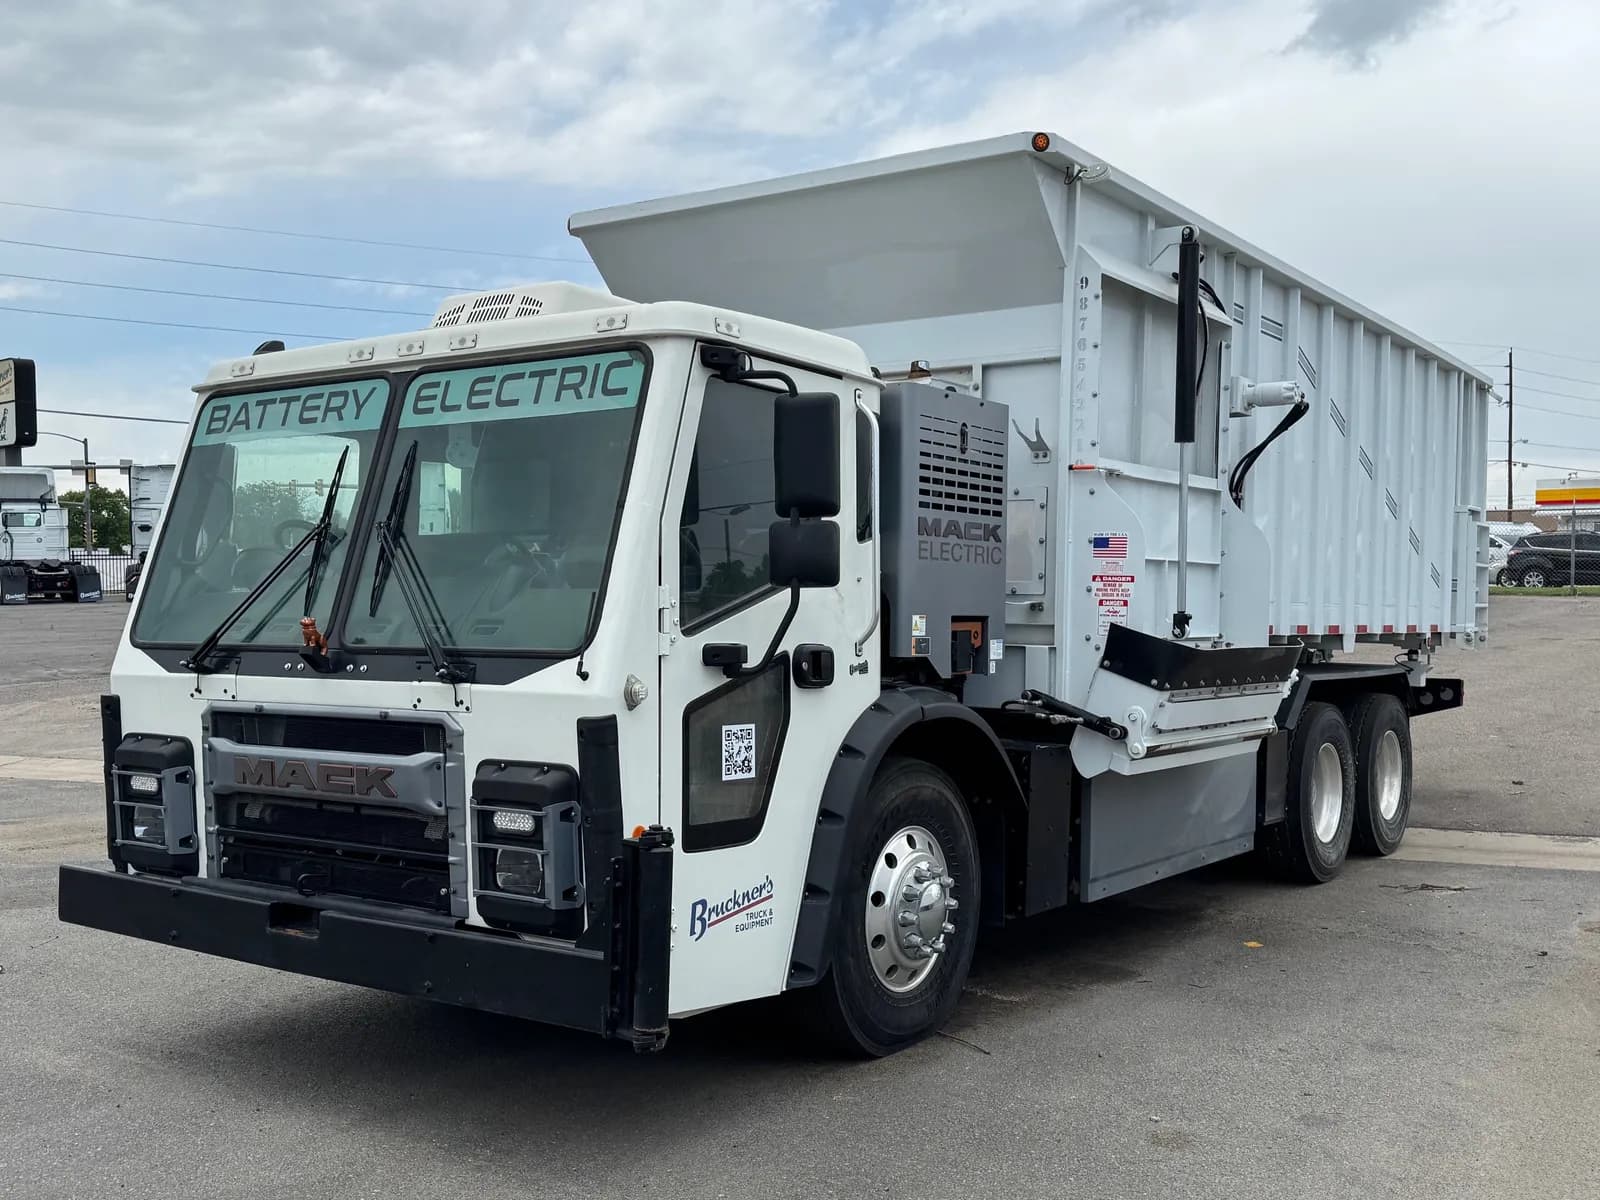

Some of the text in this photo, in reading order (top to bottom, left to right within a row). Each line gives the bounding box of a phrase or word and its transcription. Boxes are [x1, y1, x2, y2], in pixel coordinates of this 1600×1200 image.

[1080, 276, 1089, 290] 9
[1079, 297, 1088, 310] 8
[1079, 317, 1088, 331] 7
[205, 359, 634, 435] BATTERY ELECTRIC
[917, 516, 1002, 543] MACK
[918, 540, 1003, 565] ELECTRIC
[233, 756, 398, 799] MACK
[689, 874, 774, 942] Bruckner's
[746, 908, 773, 920] TRUCK &
[736, 917, 773, 932] EQUIPMENT
